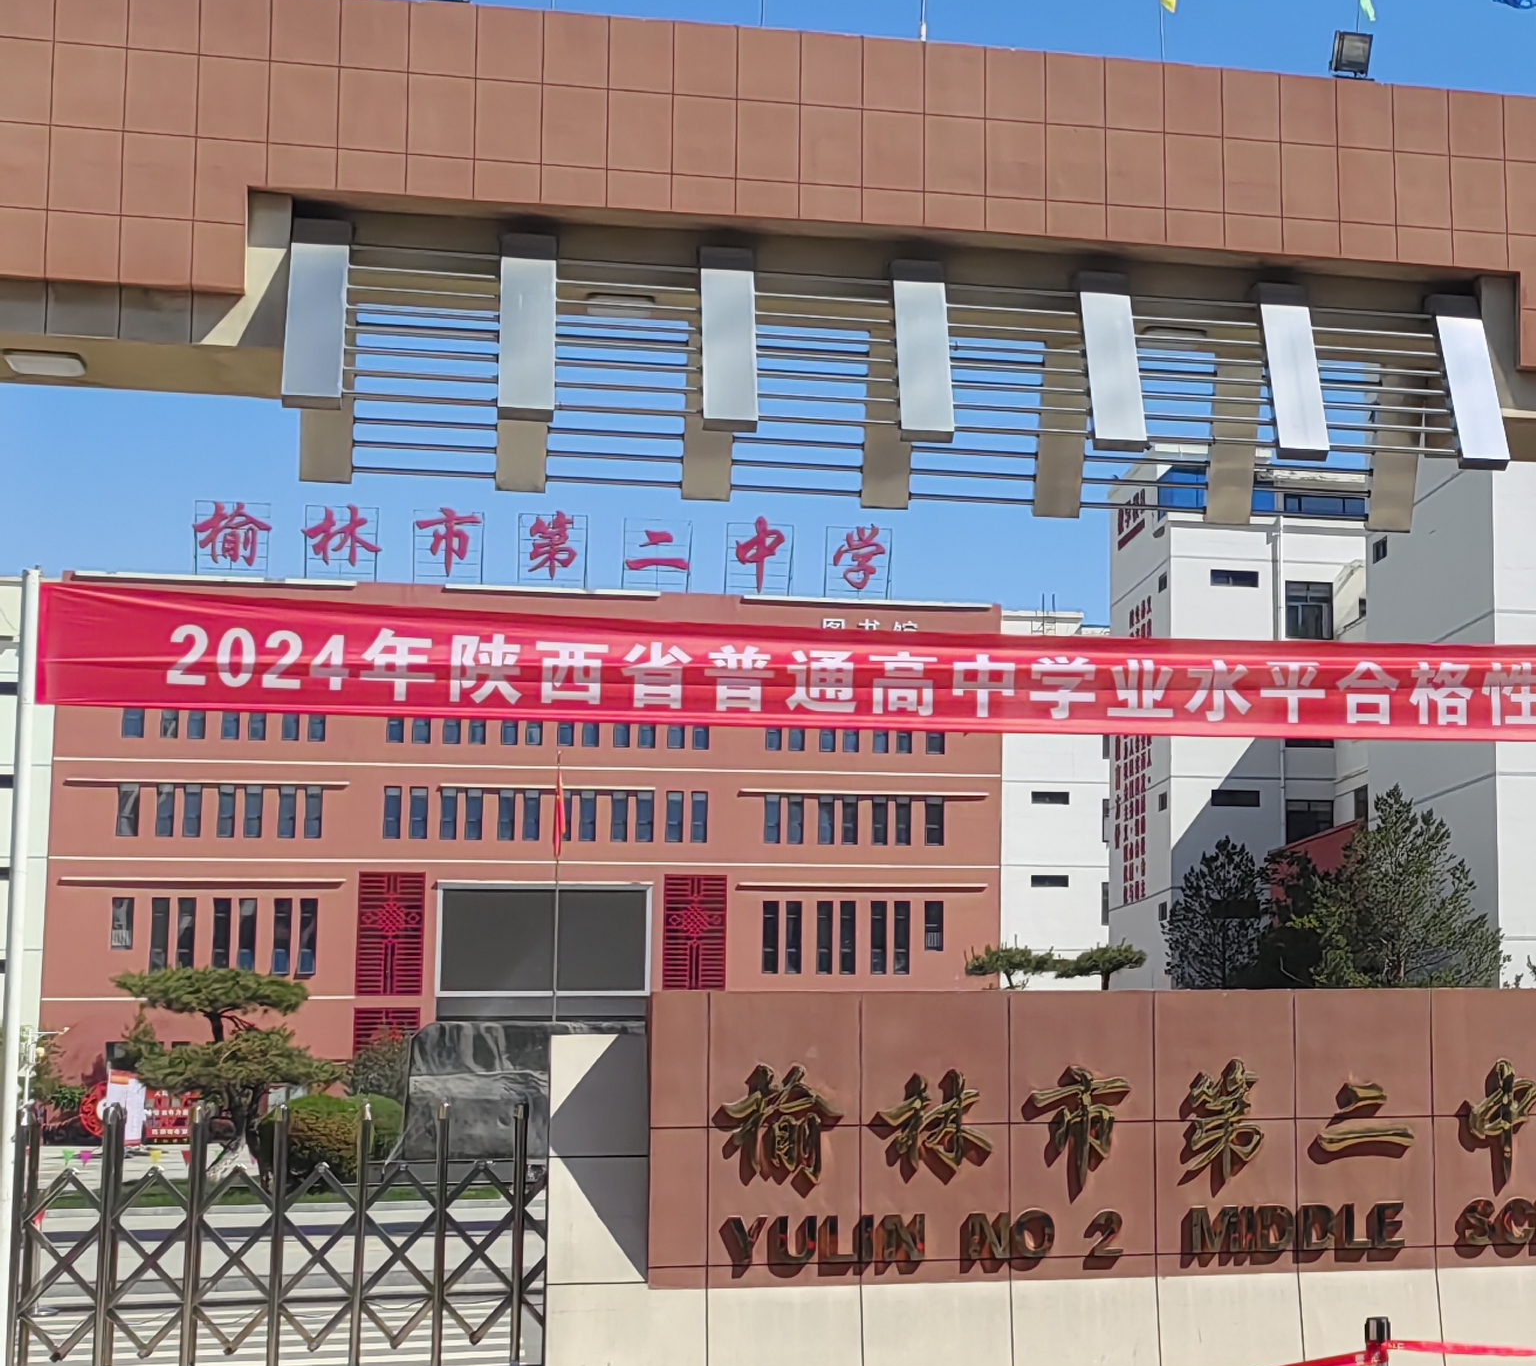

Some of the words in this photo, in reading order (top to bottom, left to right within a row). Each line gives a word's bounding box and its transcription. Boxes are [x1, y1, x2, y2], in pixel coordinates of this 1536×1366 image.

[192, 499, 889, 591] 榆林市第二中学
[721, 1212, 926, 1271] YULIN
[962, 1208, 1056, 1267] NO
[1083, 1209, 1124, 1265] 2
[1183, 1200, 1405, 1261] MIDDLE
